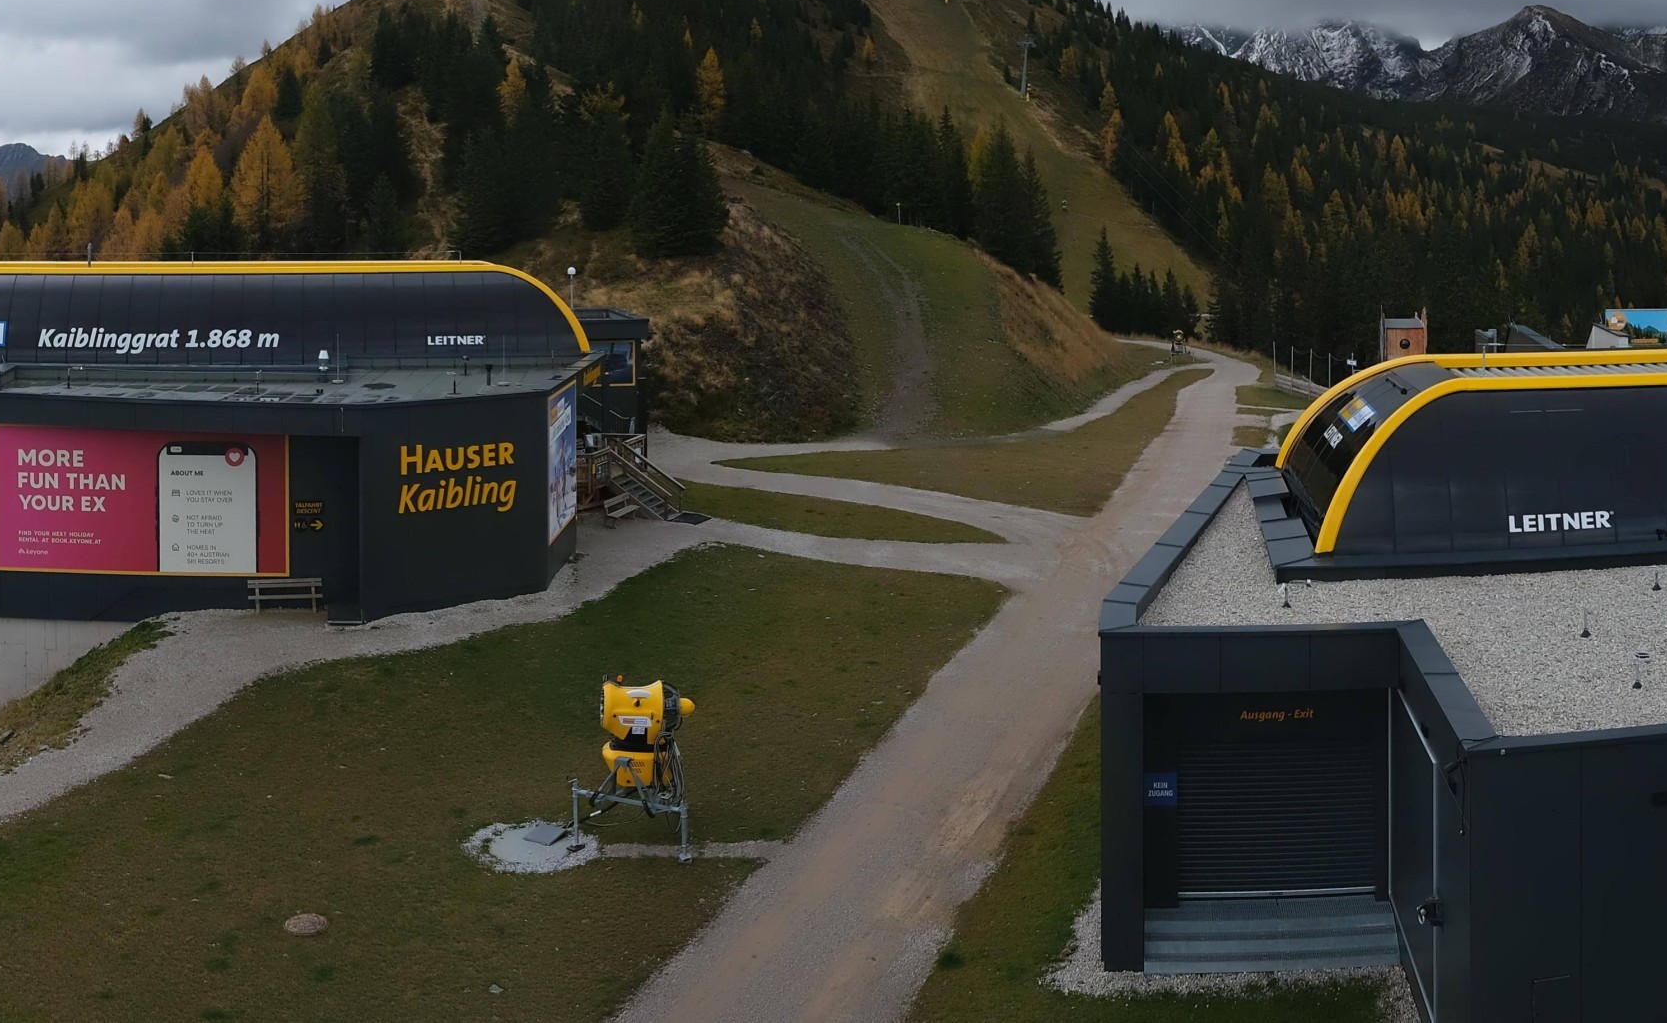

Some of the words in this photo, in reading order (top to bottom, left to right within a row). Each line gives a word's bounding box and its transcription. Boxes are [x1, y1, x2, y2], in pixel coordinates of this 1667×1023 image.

[38, 328, 180, 354] Kaiblinggrat
[185, 329, 252, 348] 1.868
[257, 332, 280, 348] m
[427, 335, 484, 346] LEITNER
[17, 448, 84, 467] MORE
[400, 442, 515, 476] HAUSER
[18, 472, 59, 489] FUN
[66, 473, 126, 491] THAN
[19, 494, 74, 511] YOUR
[81, 496, 106, 512] EX
[398, 476, 517, 514] Kaibling
[1508, 511, 1613, 533] LEITNER
[1240, 710, 1285, 722] Ausgang
[1294, 708, 1314, 719] Exit
